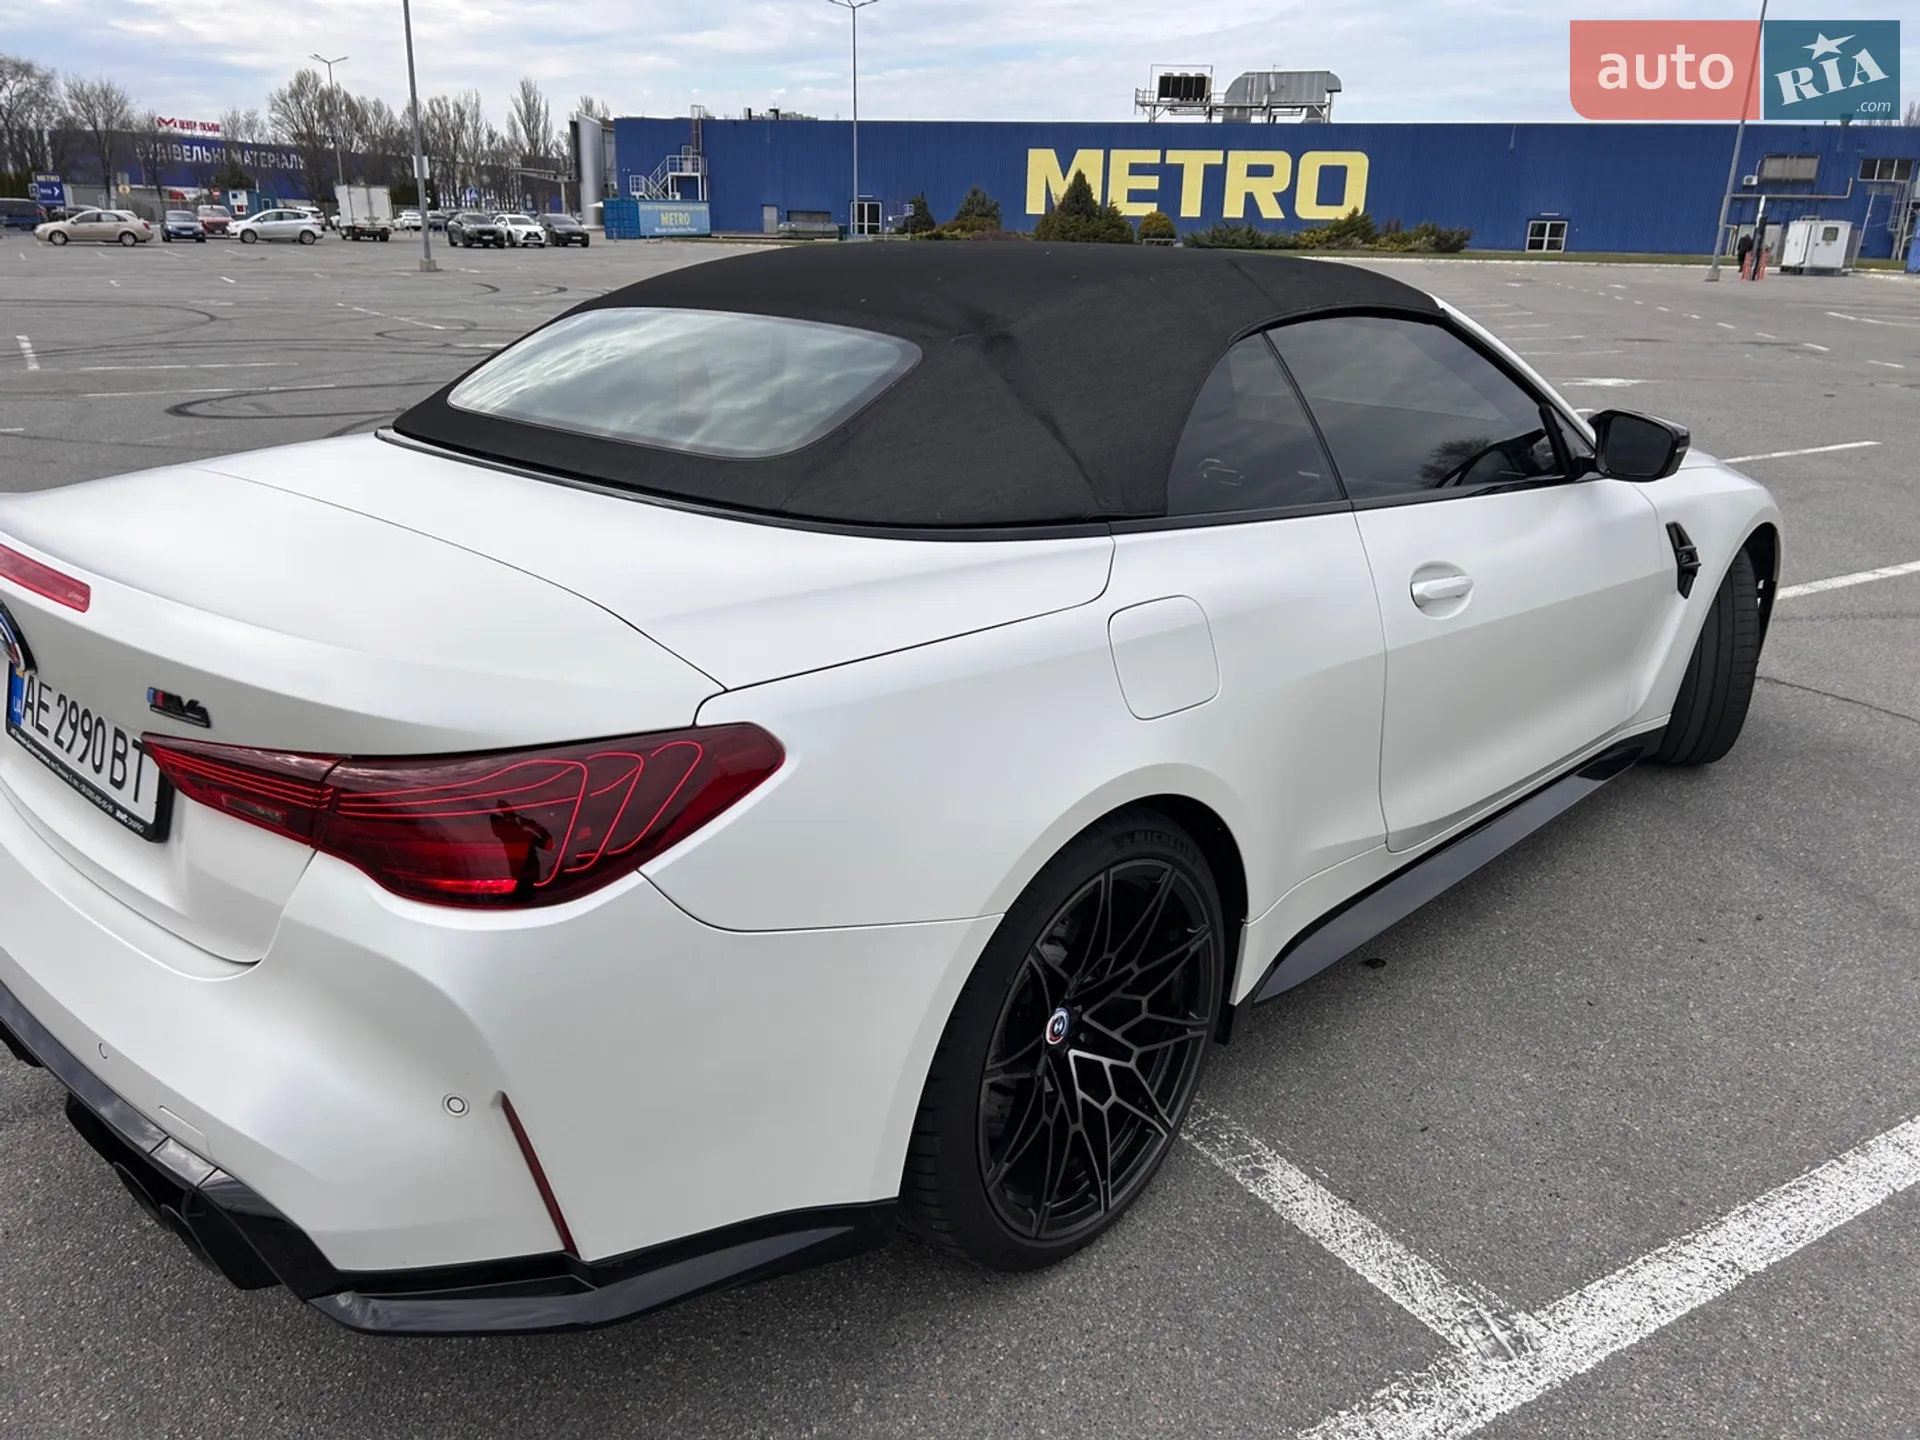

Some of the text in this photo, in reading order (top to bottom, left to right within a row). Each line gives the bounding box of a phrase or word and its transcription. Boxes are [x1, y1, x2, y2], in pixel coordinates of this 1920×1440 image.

[661, 212, 690, 226] METRO
[1025, 148, 1369, 220] METRO
[22, 674, 52, 738] AE
[54, 693, 106, 774] 2990
[110, 727, 148, 803] BT
